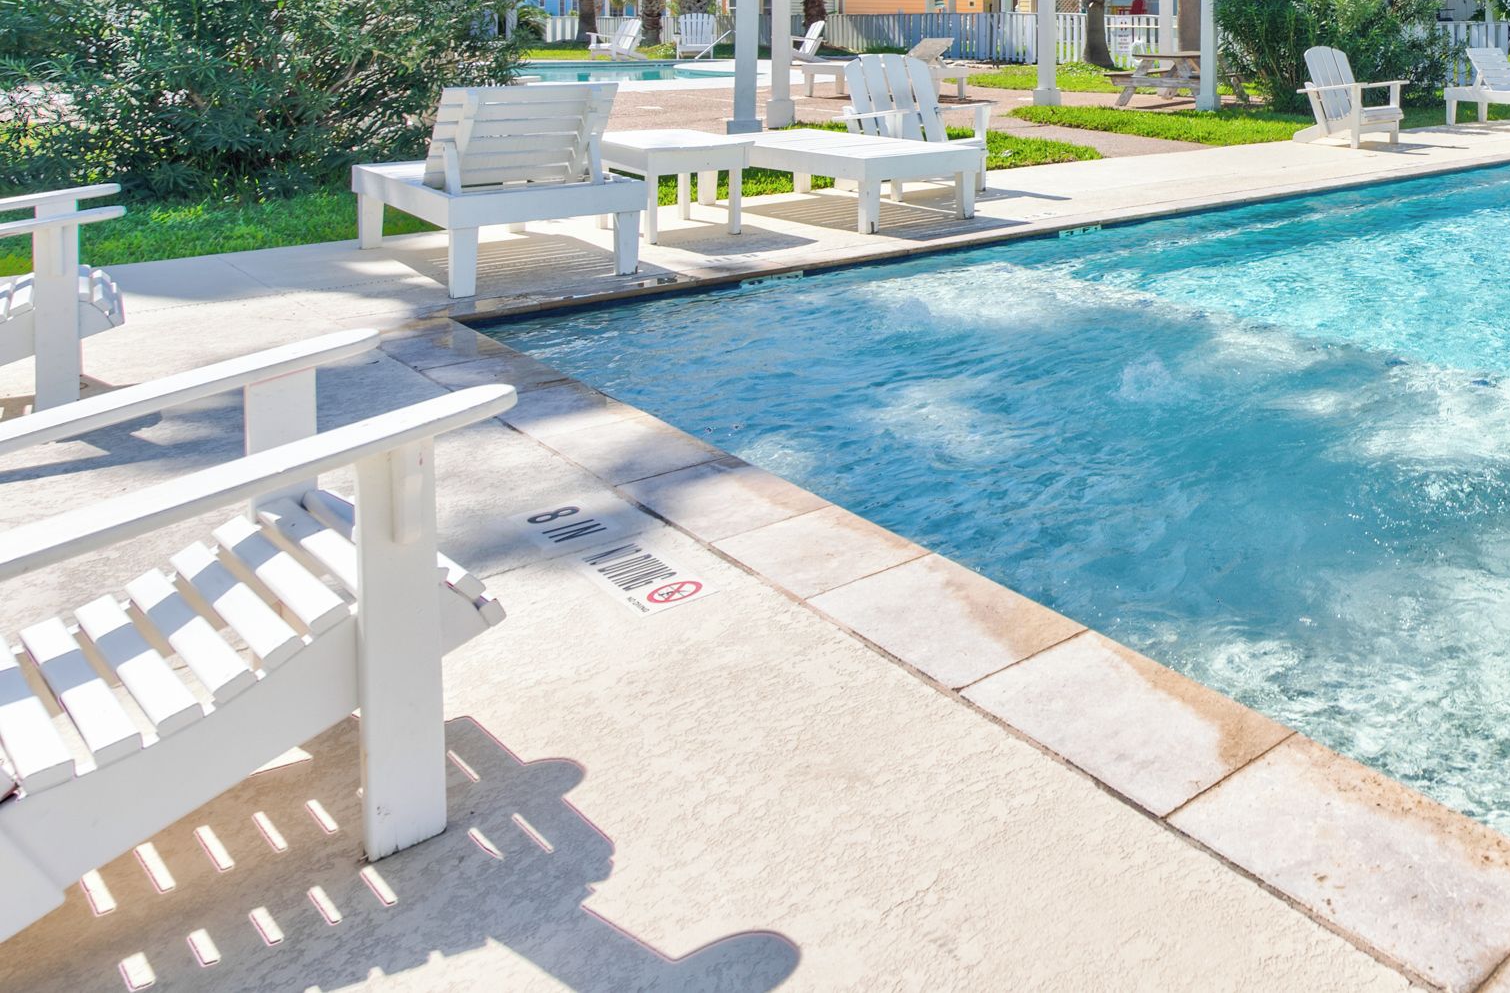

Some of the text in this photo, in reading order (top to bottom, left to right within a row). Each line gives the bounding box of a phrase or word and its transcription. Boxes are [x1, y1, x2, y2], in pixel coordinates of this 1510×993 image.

[527, 506, 607, 543] 8 IN
[582, 543, 677, 591] NO DIVING
